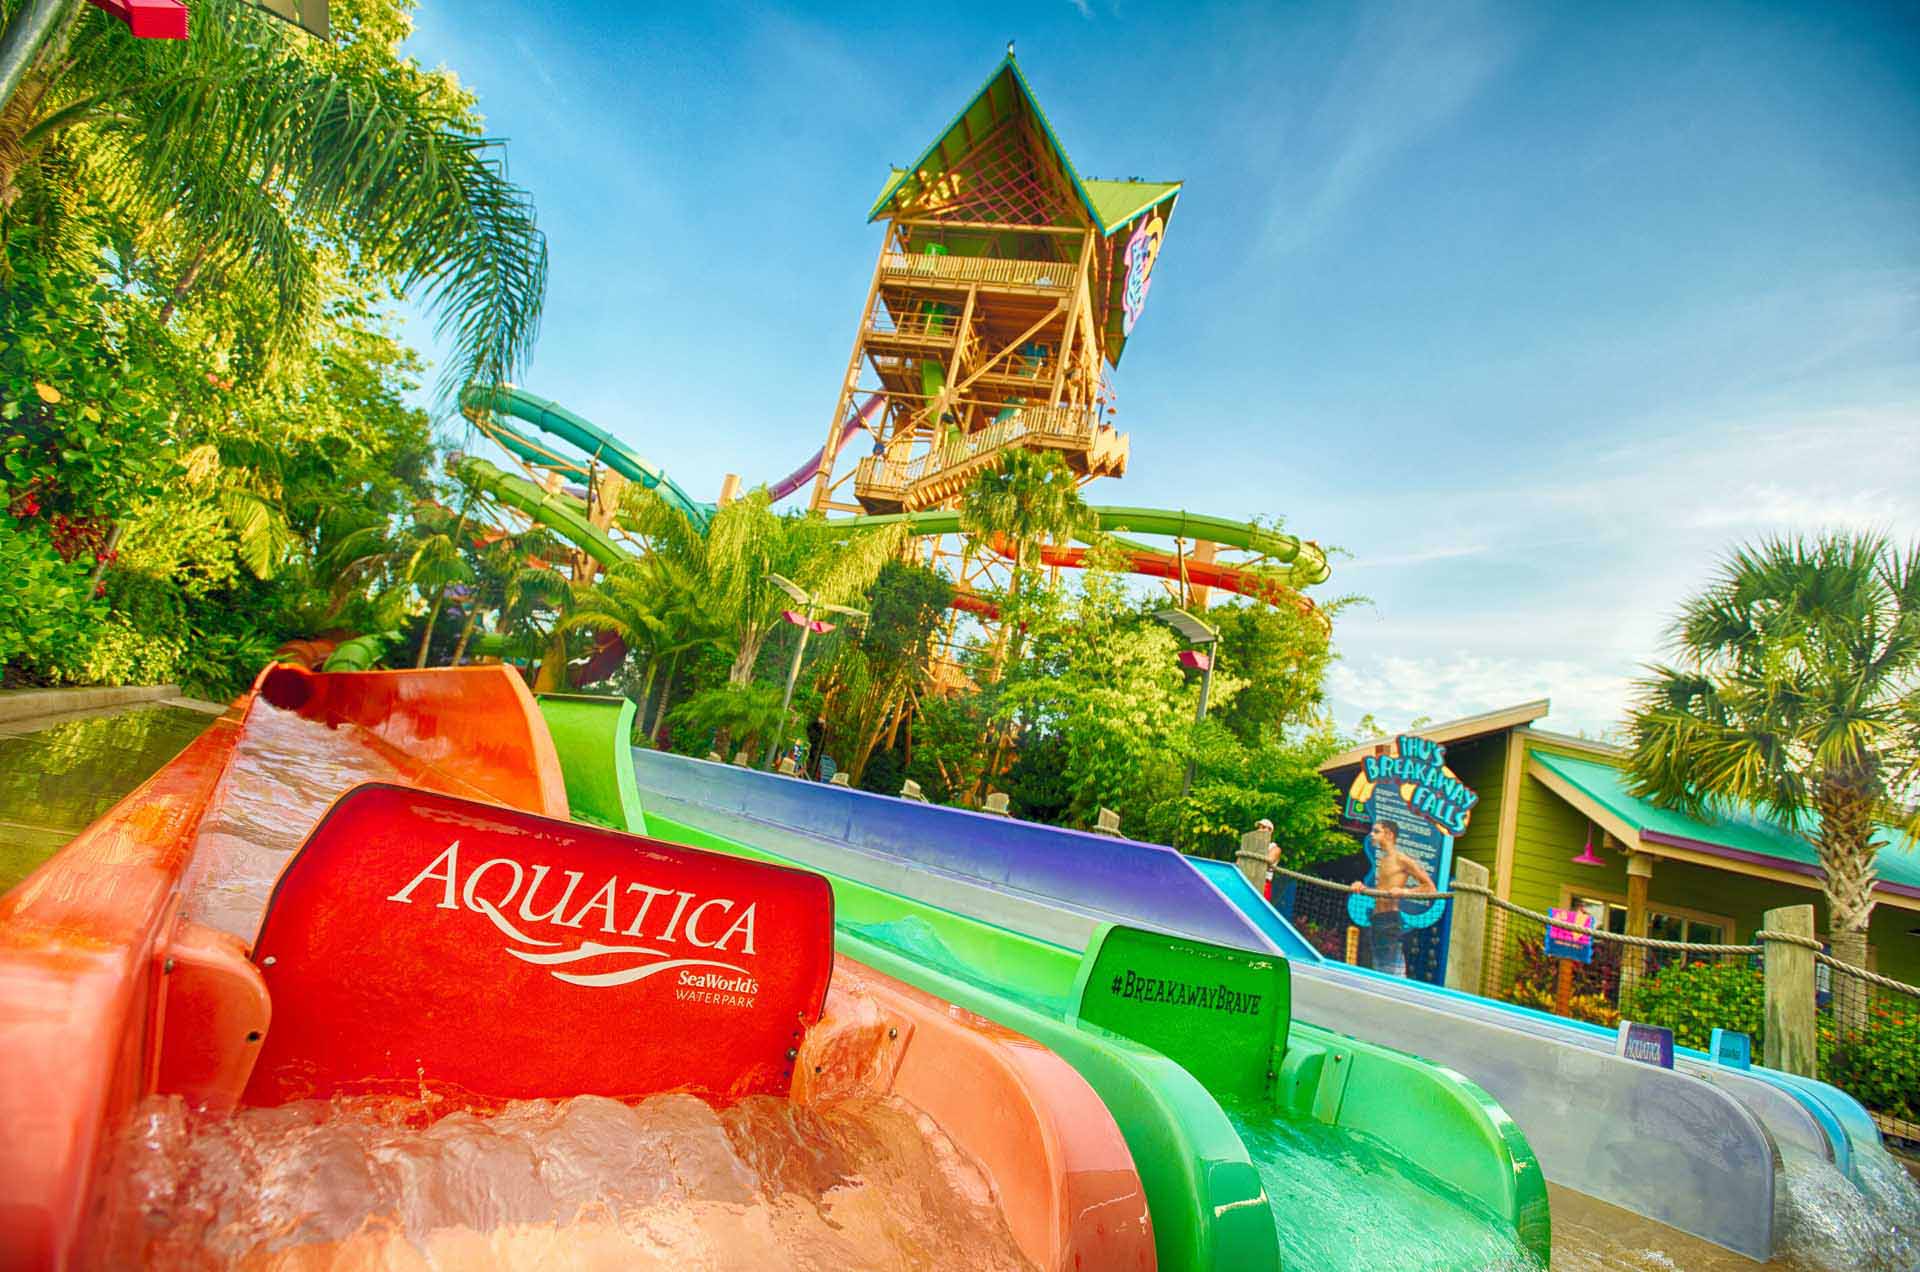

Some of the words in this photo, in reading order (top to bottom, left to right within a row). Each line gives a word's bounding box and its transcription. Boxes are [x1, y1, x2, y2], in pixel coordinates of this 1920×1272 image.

[1365, 754, 1479, 809] BREAKAWAY
[1412, 786, 1467, 832] FALLS
[387, 839, 758, 955] AQUATICA
[675, 989, 755, 1008] WATERPARK
[678, 970, 759, 994] SeaWorld's
[1111, 970, 1262, 1015] #BREAKAWAYBRAVE
